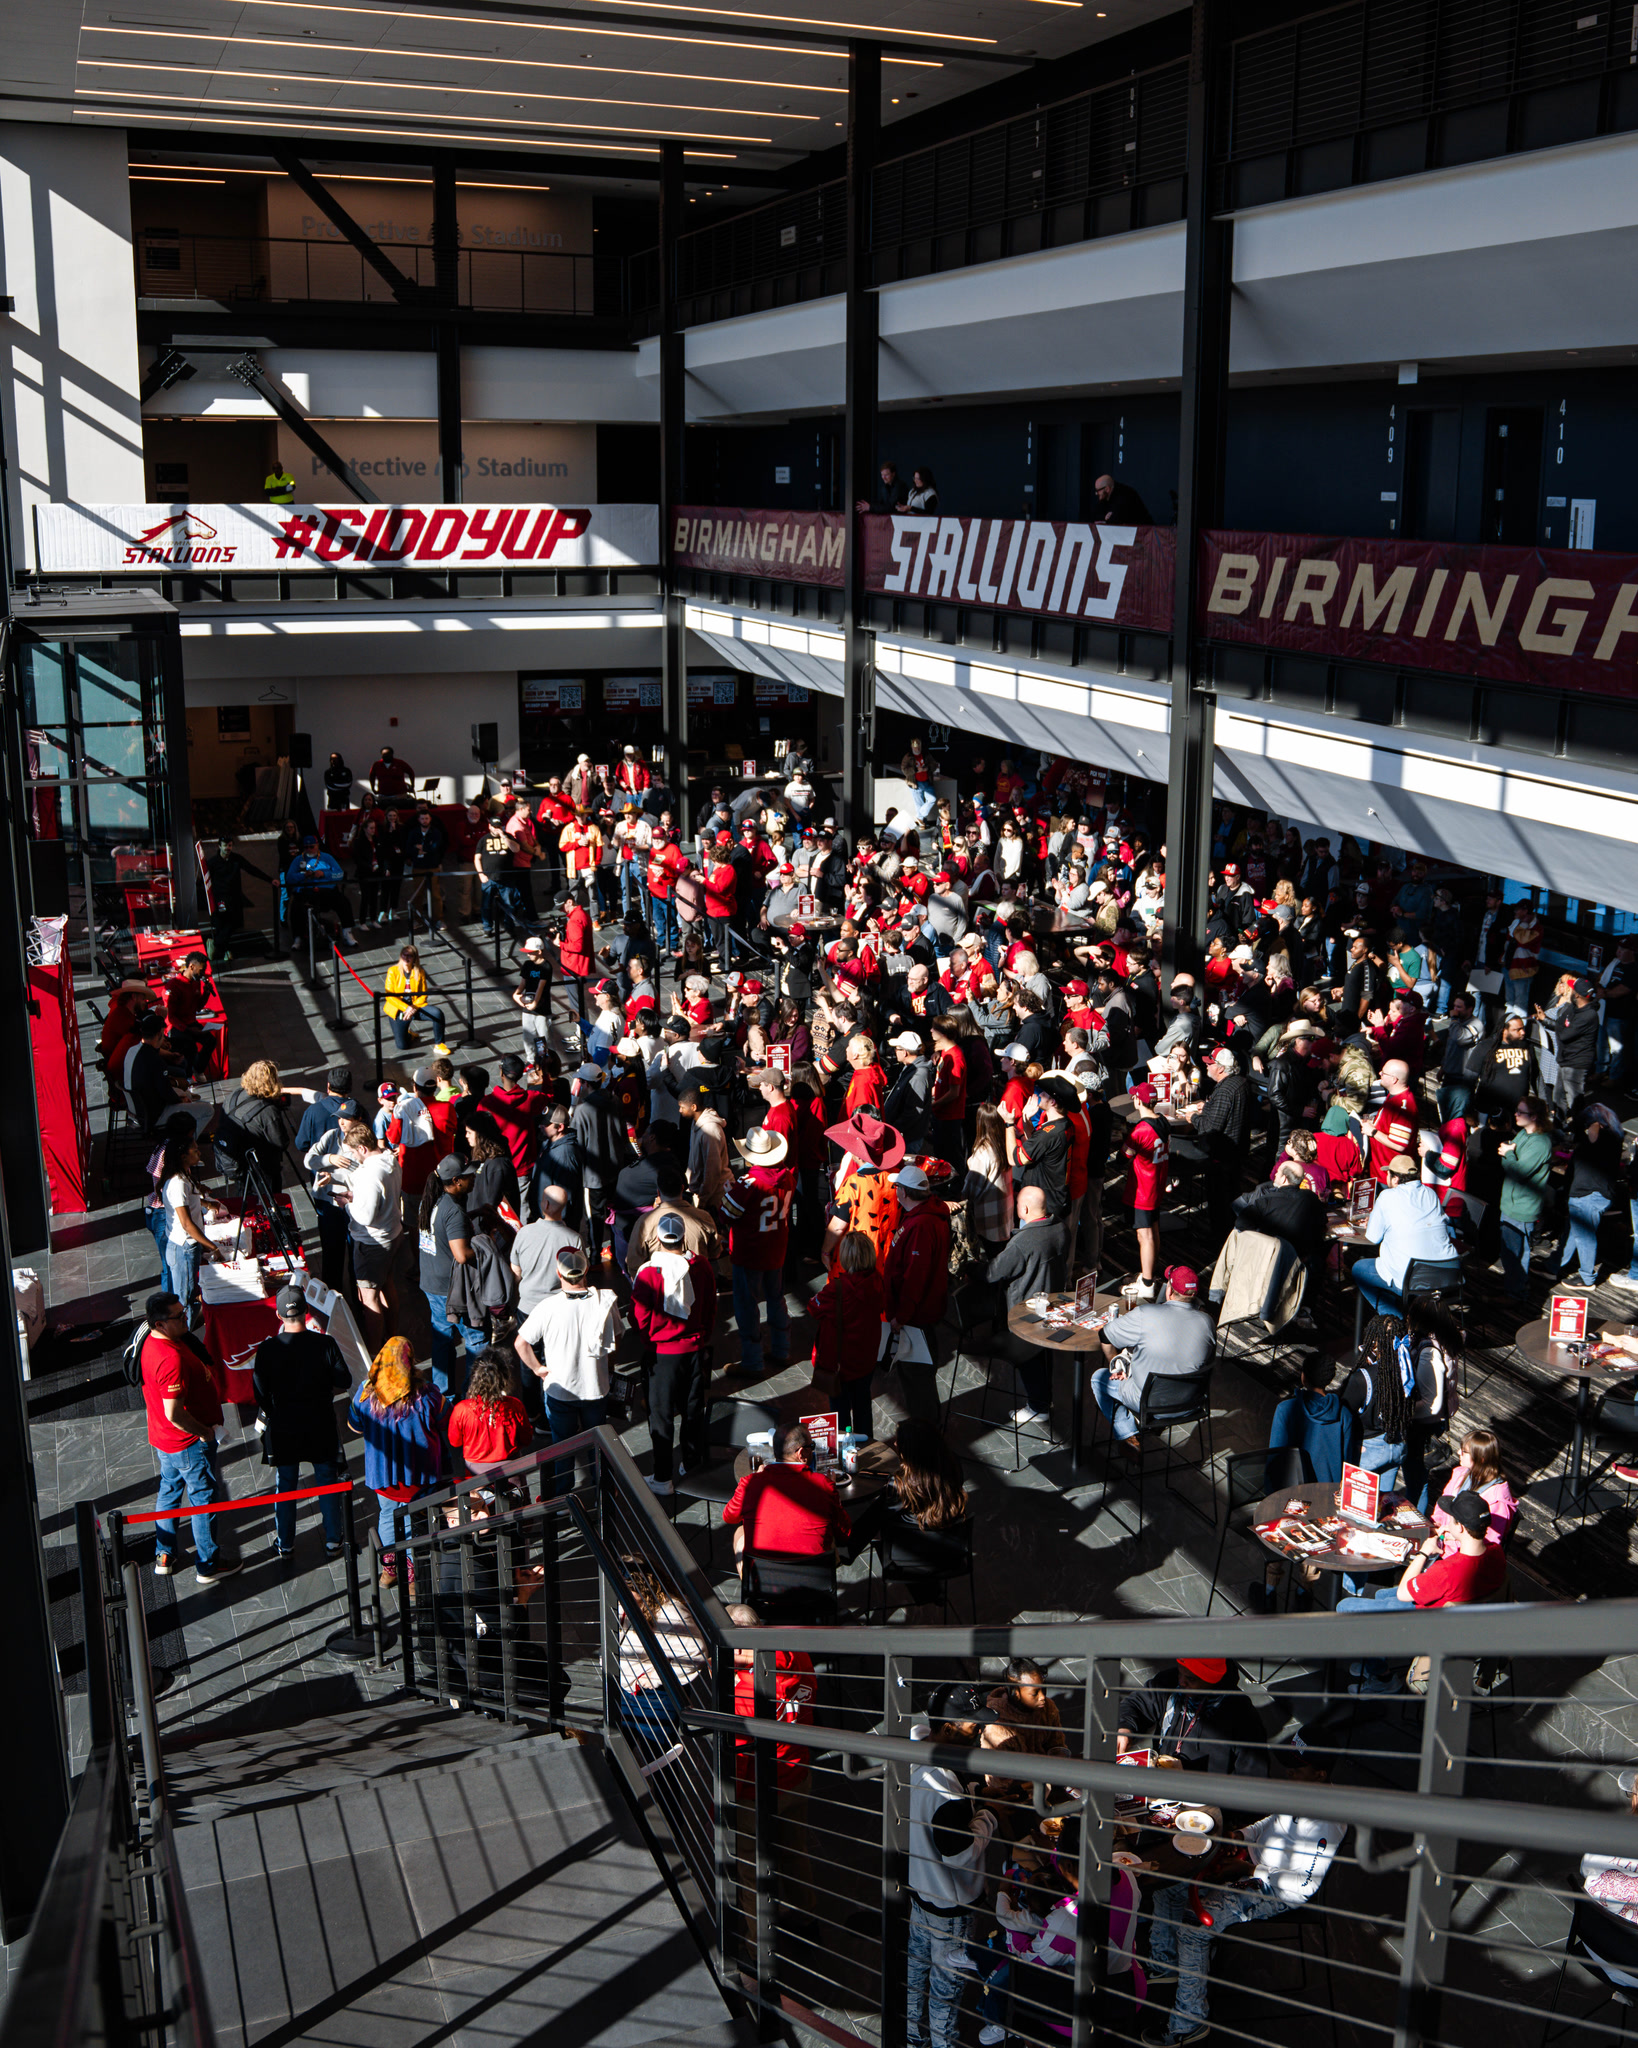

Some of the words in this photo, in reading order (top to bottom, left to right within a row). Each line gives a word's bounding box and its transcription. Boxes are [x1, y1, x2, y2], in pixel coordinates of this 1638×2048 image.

[301, 216, 420, 241] Proctive
[471, 224, 563, 248] Stadium
[1387, 404, 1396, 464] 409
[1556, 399, 1567, 464] 410
[311, 456, 427, 477] Ptective
[477, 456, 568, 477] Stadium
[121, 546, 238, 564] STALLIONS
[271, 508, 591, 561] #GIDDYUP
[674, 517, 846, 569] BIRMINGHAM
[883, 514, 1138, 619] STALLIONS
